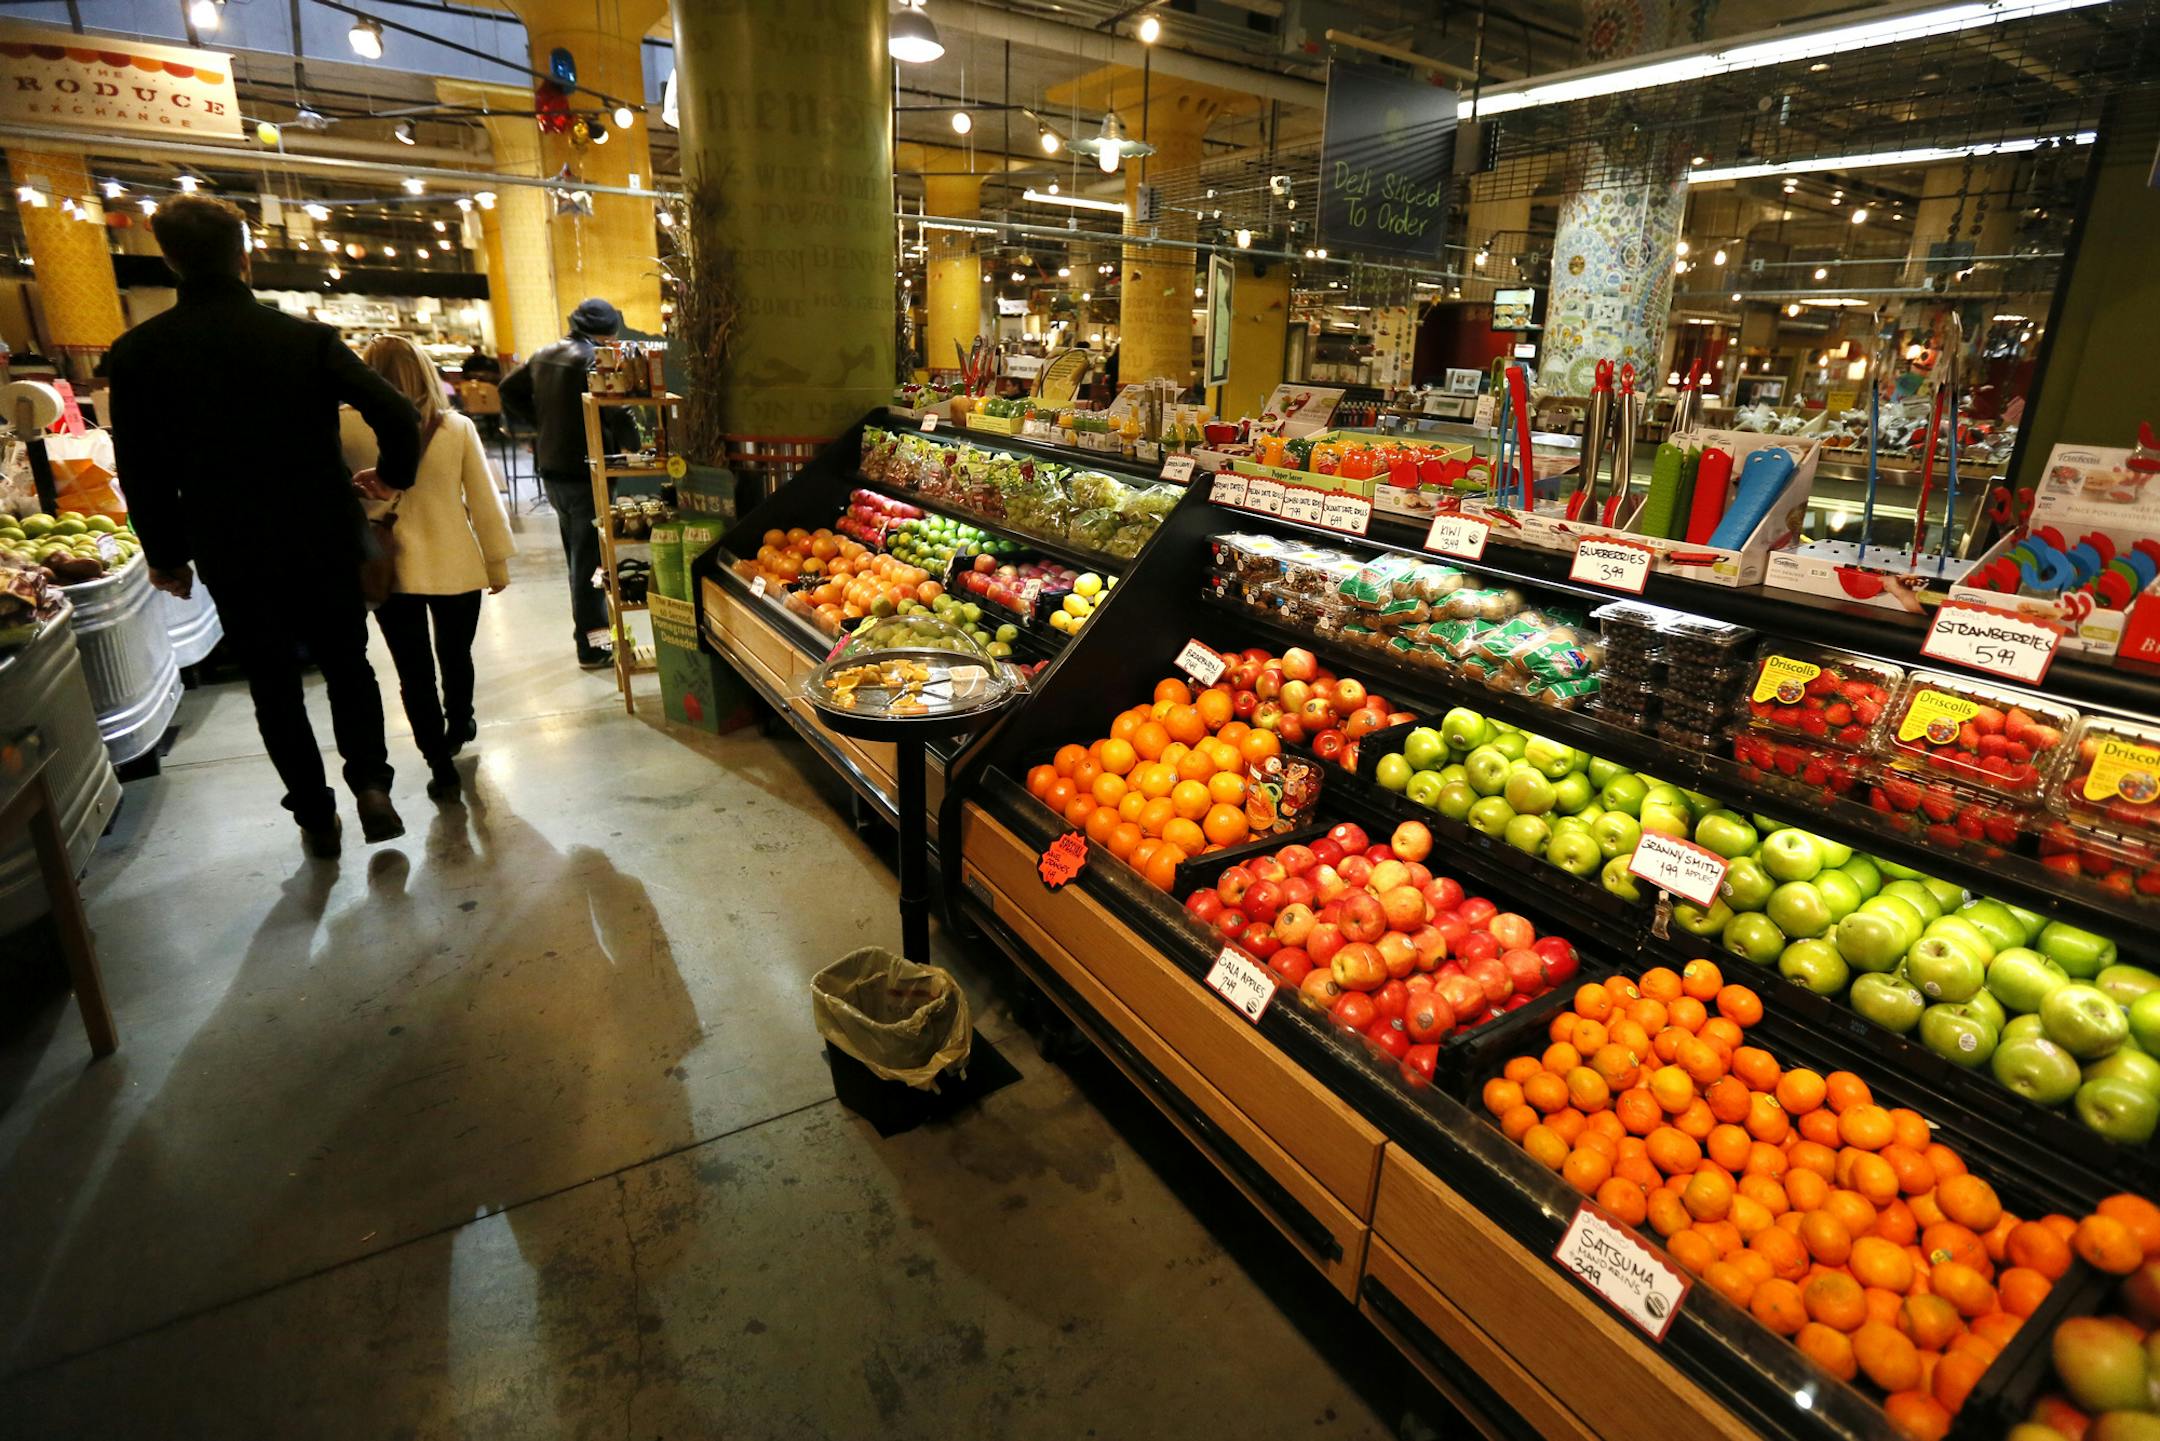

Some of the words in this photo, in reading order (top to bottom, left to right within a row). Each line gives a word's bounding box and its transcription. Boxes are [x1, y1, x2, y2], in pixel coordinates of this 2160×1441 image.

[85, 67, 123, 79] THE
[13, 75, 225, 116] RODUCE
[28, 102, 192, 128] EXCHANGE
[1335, 161, 1372, 196] Deli
[1382, 173, 1441, 208] Sliced
[1344, 197, 1367, 227] To
[1377, 203, 1428, 236] Order
[1441, 525, 1461, 537] KIWI
[1580, 545, 1646, 565] BLUEBERRIES
[1936, 620, 2054, 652] STRAWBERRIES
[1641, 838, 1685, 862] GRANNY
[1685, 855, 1720, 878] SMITH
[1241, 971, 1266, 999] APPLES
[1581, 1228, 1654, 1289] SATSUMA
